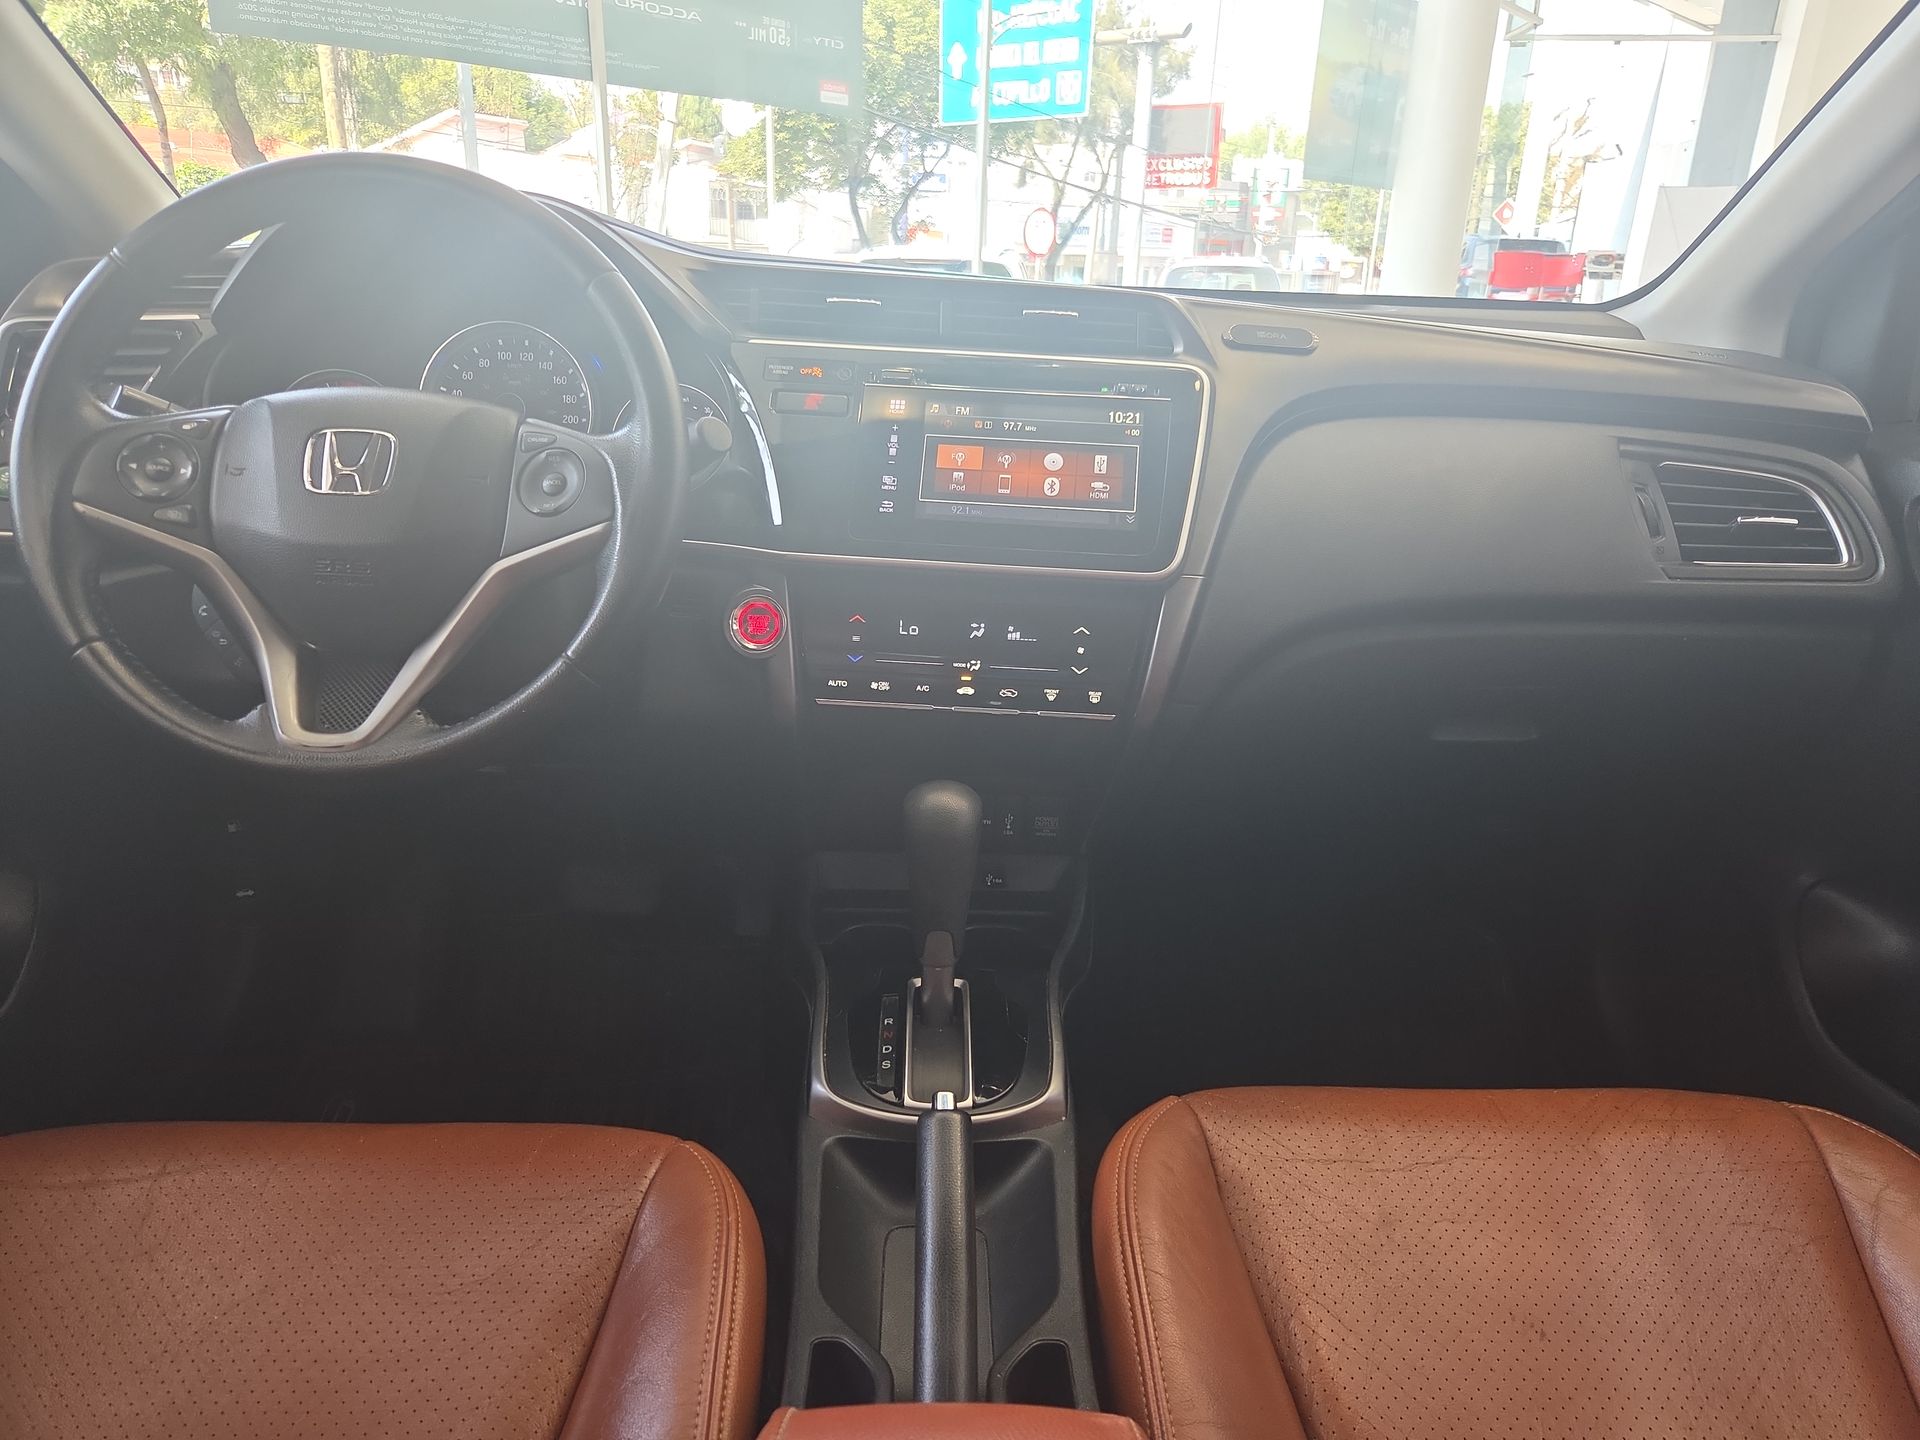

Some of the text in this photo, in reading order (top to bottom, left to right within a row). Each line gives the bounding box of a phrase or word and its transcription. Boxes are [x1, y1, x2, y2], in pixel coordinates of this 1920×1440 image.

[497, 351, 512, 361] 100
[519, 351, 534, 361] 120
[478, 359, 490, 368] 80
[538, 361, 553, 370] 140
[462, 371, 473, 381] 60
[552, 375, 567, 385] 160
[562, 394, 577, 404] 180
[955, 406, 970, 416] FM
[562, 415, 579, 424] 200
[1108, 410, 1141, 424] 10:21
[1003, 421, 1022, 431] 97.7
[949, 483, 967, 492] iPod
[1090, 491, 1109, 500] HDMI
[952, 505, 971, 515] 92.1
[899, 619, 919, 635] Lo
[828, 679, 848, 687] AUTO
[916, 684, 930, 692] A/C
[883, 1031, 893, 1039] N
[882, 1045, 892, 1053] D
[881, 1060, 890, 1069] S
